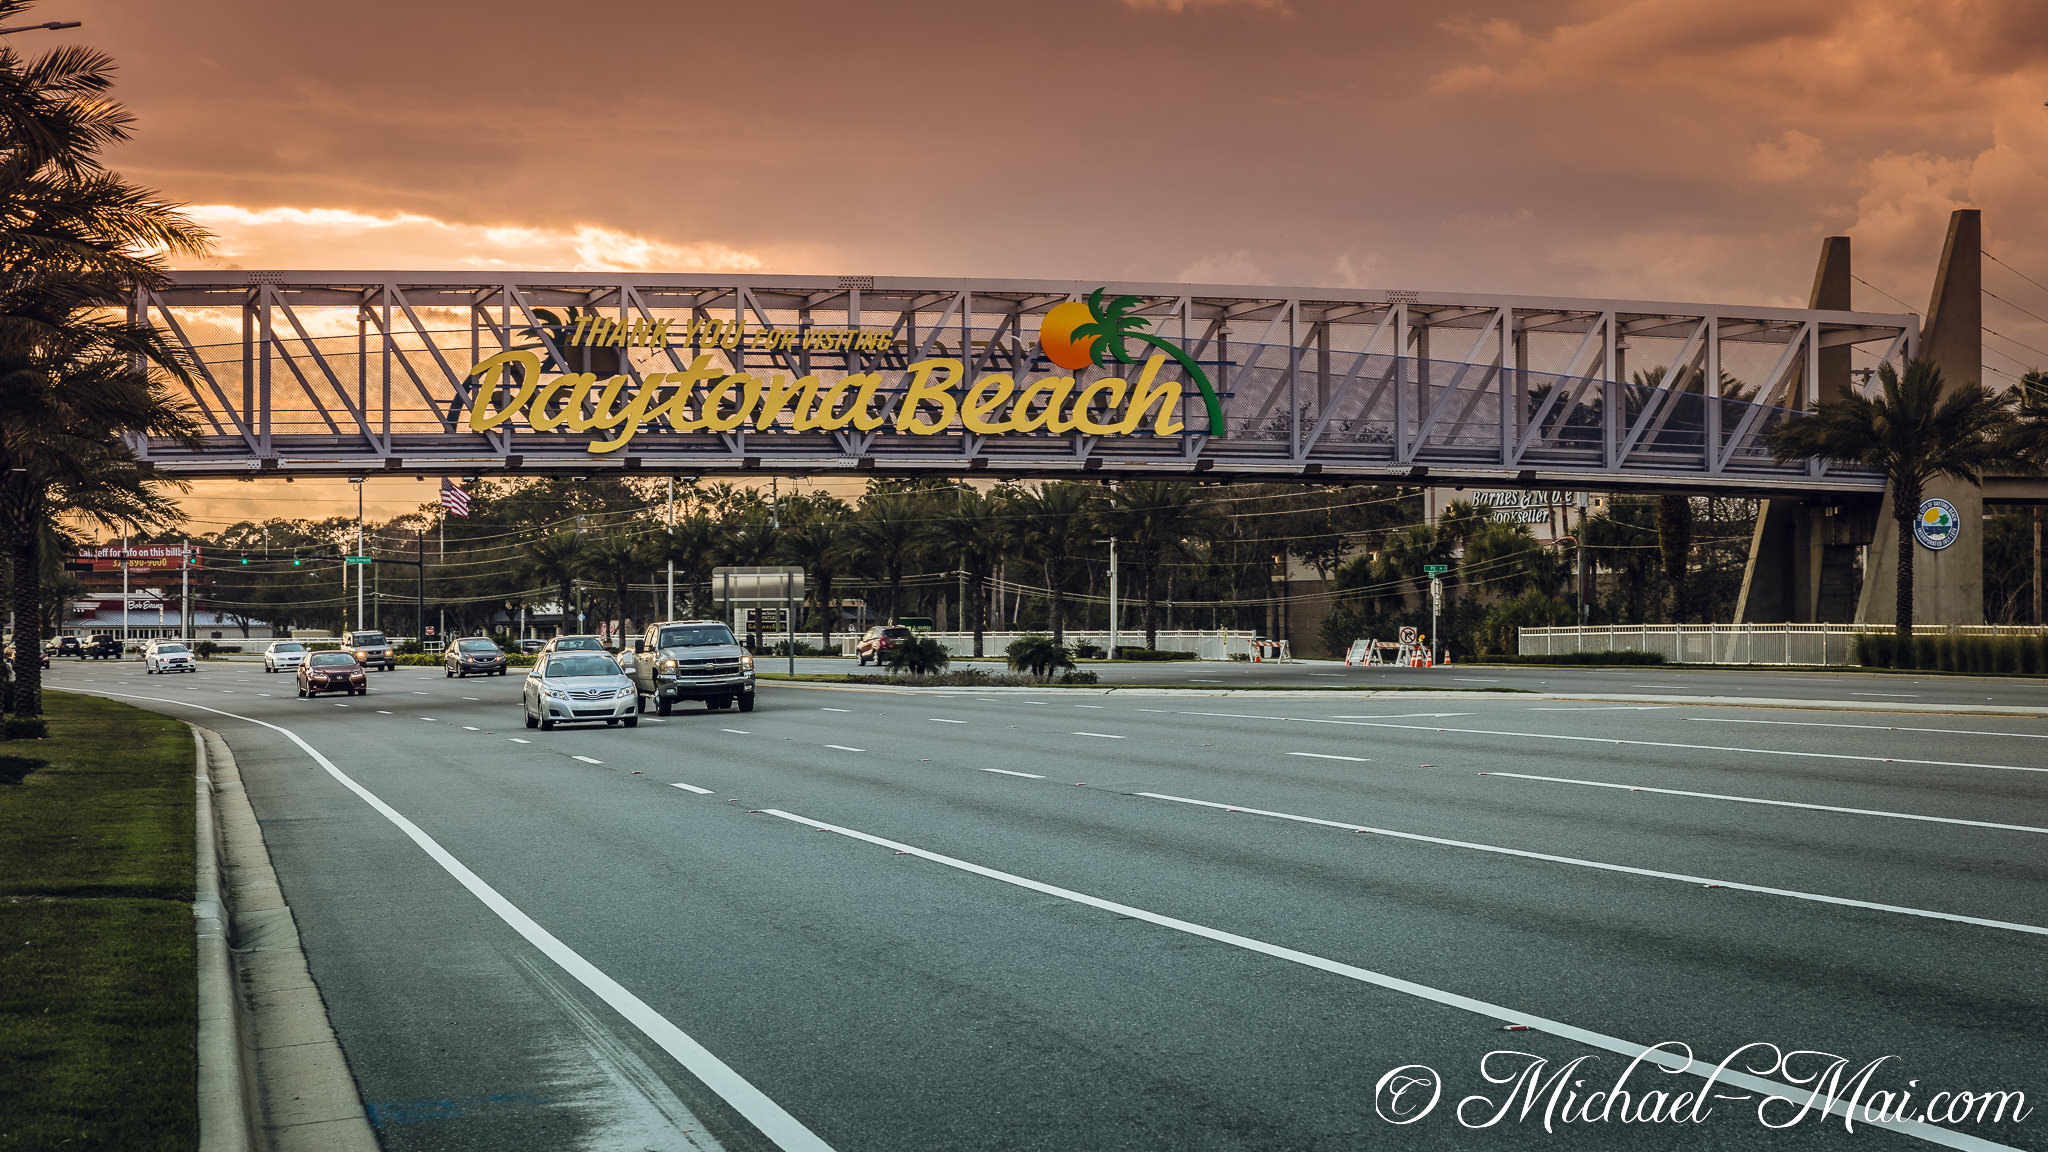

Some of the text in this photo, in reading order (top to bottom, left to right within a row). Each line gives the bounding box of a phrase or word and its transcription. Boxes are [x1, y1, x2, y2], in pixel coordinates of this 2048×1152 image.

[571, 316, 894, 351] THANK YOU FOR VISITING
[469, 349, 1184, 453] Daytona Beach
[1472, 490, 1518, 507] Barnes
[1520, 490, 1532, 509] &
[109, 547, 120, 557] for
[122, 547, 137, 557] nfo
[138, 549, 149, 557] on
[149, 547, 165, 557] this
[127, 600, 164, 610] Bob Evans
